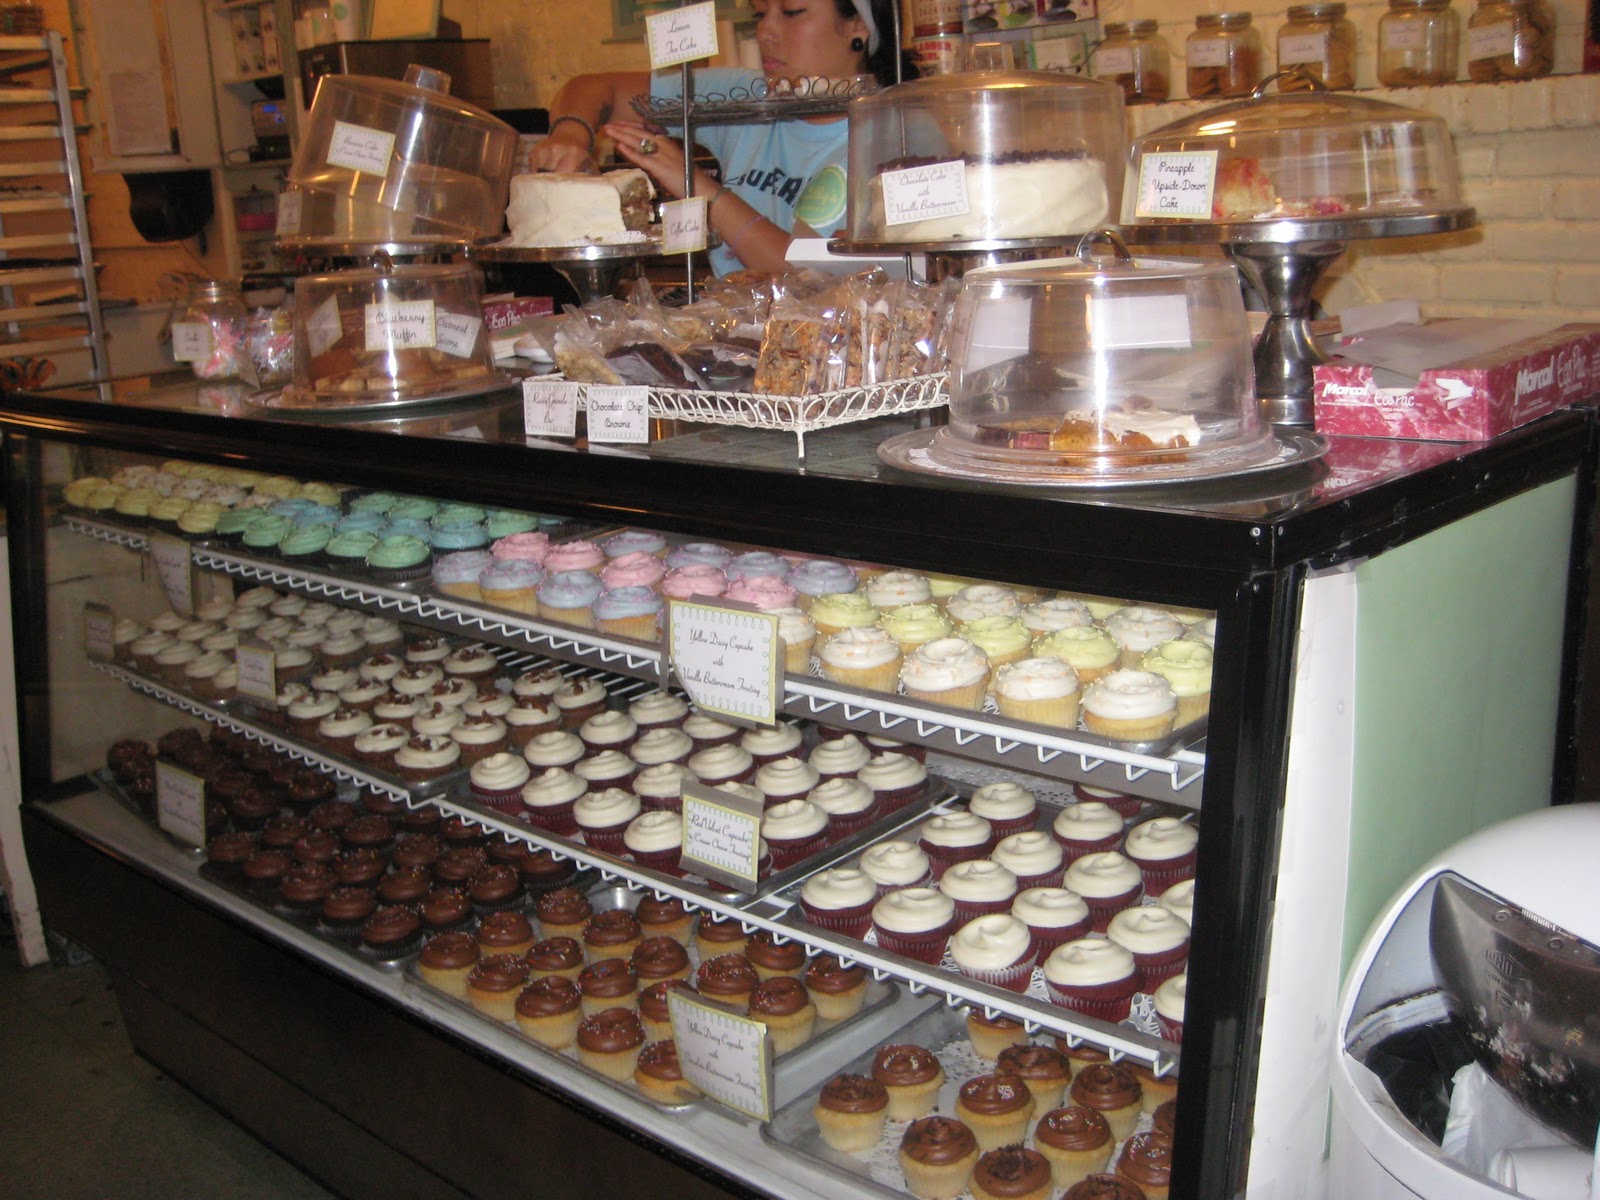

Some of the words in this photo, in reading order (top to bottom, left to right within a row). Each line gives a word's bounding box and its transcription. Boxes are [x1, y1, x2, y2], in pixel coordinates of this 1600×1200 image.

[680, 37, 697, 51] Cake
[1158, 161, 1195, 176] Pineapple
[900, 173, 929, 186] Chocolate
[930, 169, 947, 181] Cake
[918, 186, 930, 197] with
[1152, 179, 1207, 193] Upside-Down
[897, 201, 918, 214] Vanilla
[920, 199, 957, 210] Buttercream
[1160, 196, 1178, 208] Cake
[684, 218, 699, 232] Cake
[376, 312, 425, 324] Blueberry
[437, 317, 469, 334] Oatmeal
[383, 331, 416, 343] Muffin
[1322, 383, 1369, 397] Marcal
[591, 400, 623, 412] Chocolate
[626, 400, 643, 414] Chip
[605, 417, 631, 428] Brownie
[689, 628, 708, 644] Yellow
[709, 632, 728, 650] Daisy
[729, 635, 754, 652] Cupcake
[713, 656, 724, 666] with
[683, 667, 702, 682] Vanilla
[703, 672, 736, 690] Buttercream
[737, 678, 761, 697] Frosting
[691, 814, 703, 828] Red
[702, 818, 721, 834] Velvet
[722, 824, 748, 844] Cupcake
[687, 1019, 703, 1036] Yellow
[721, 1033, 744, 1051] Cupcake
